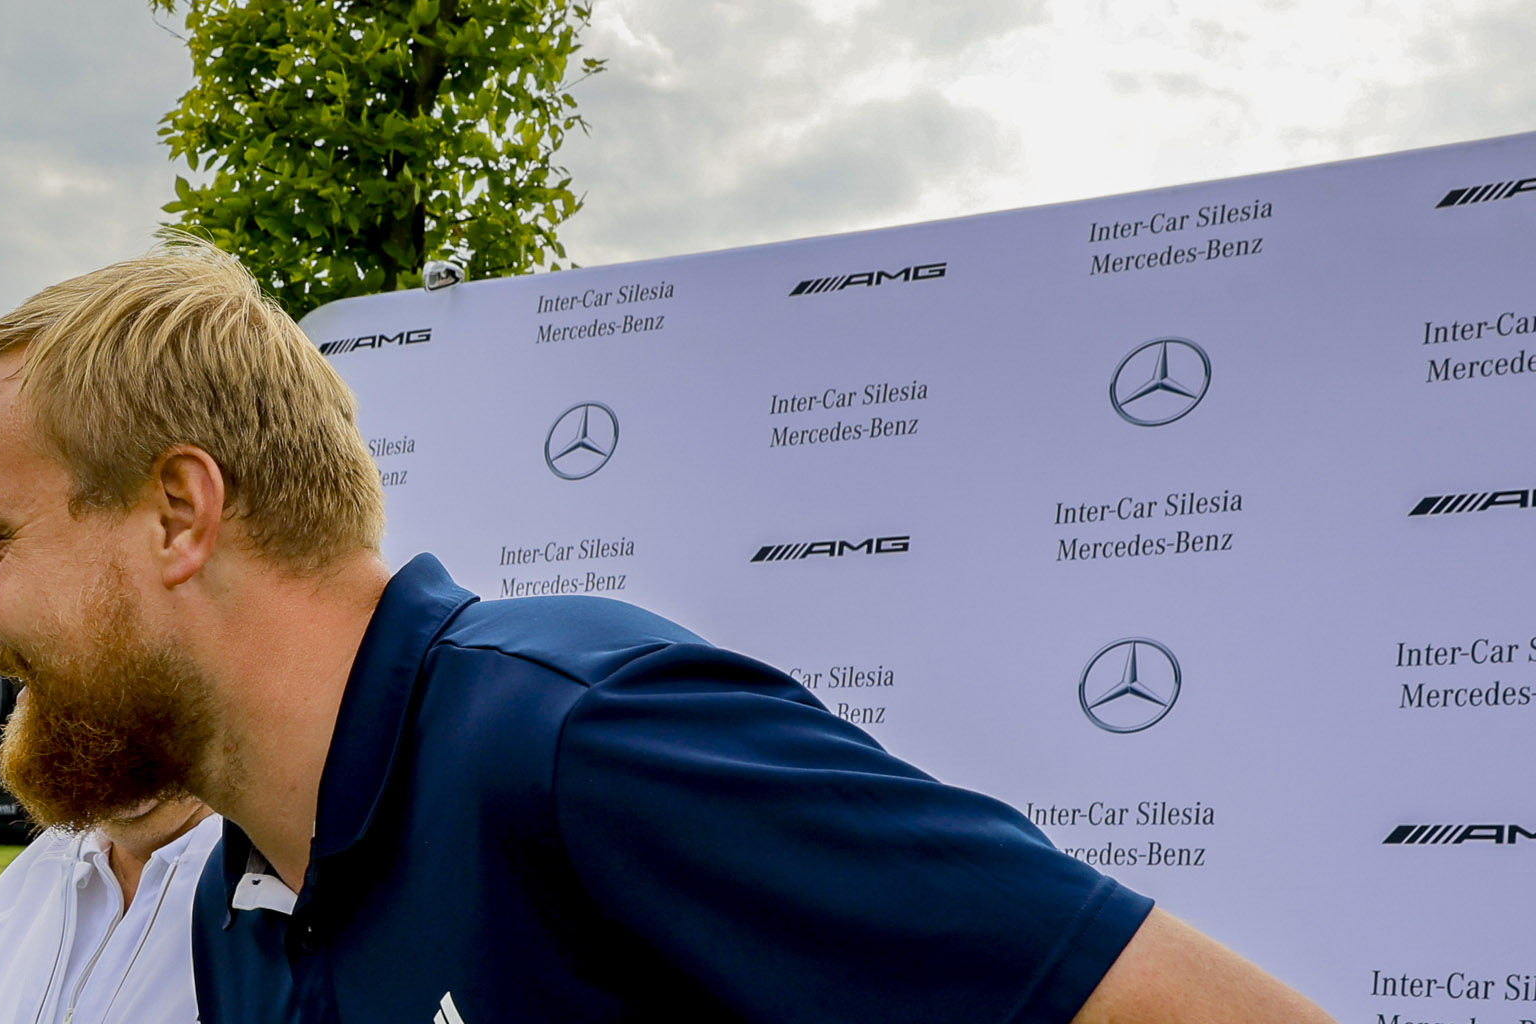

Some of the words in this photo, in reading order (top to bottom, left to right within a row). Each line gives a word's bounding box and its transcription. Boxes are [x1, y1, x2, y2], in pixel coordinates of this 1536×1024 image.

[1089, 213, 1191, 243] Inter-Car
[1195, 198, 1273, 229] Silesia
[1089, 237, 1264, 276] Mercedes-Benz
[536, 288, 614, 314] Inter-Car
[616, 280, 675, 305] Silesia
[535, 314, 665, 344] Mercedes-Benz
[1425, 349, 1536, 383] Mercede
[769, 388, 858, 415] Inter-Car
[861, 380, 928, 406] Silesia
[368, 435, 415, 457] Silesia
[769, 416, 919, 448] Mercedes-Benz
[1054, 496, 1158, 525] Inter-Car
[1164, 489, 1243, 518] Silesia
[499, 542, 575, 566] Inter-Car
[577, 536, 635, 560] Silesia
[1055, 530, 1234, 562] Mercedes-Benz
[499, 571, 627, 598] Mercedes-Benz
[1395, 638, 1520, 668] Inter-Car
[828, 664, 894, 689] Silesia
[1399, 680, 1536, 709] Mercedes-
[1026, 801, 1129, 827] Inter-Car
[1135, 800, 1215, 826] Silesia
[1064, 841, 1206, 867] rcedes-Benz
[1370, 969, 1496, 1001] Inter-Car
